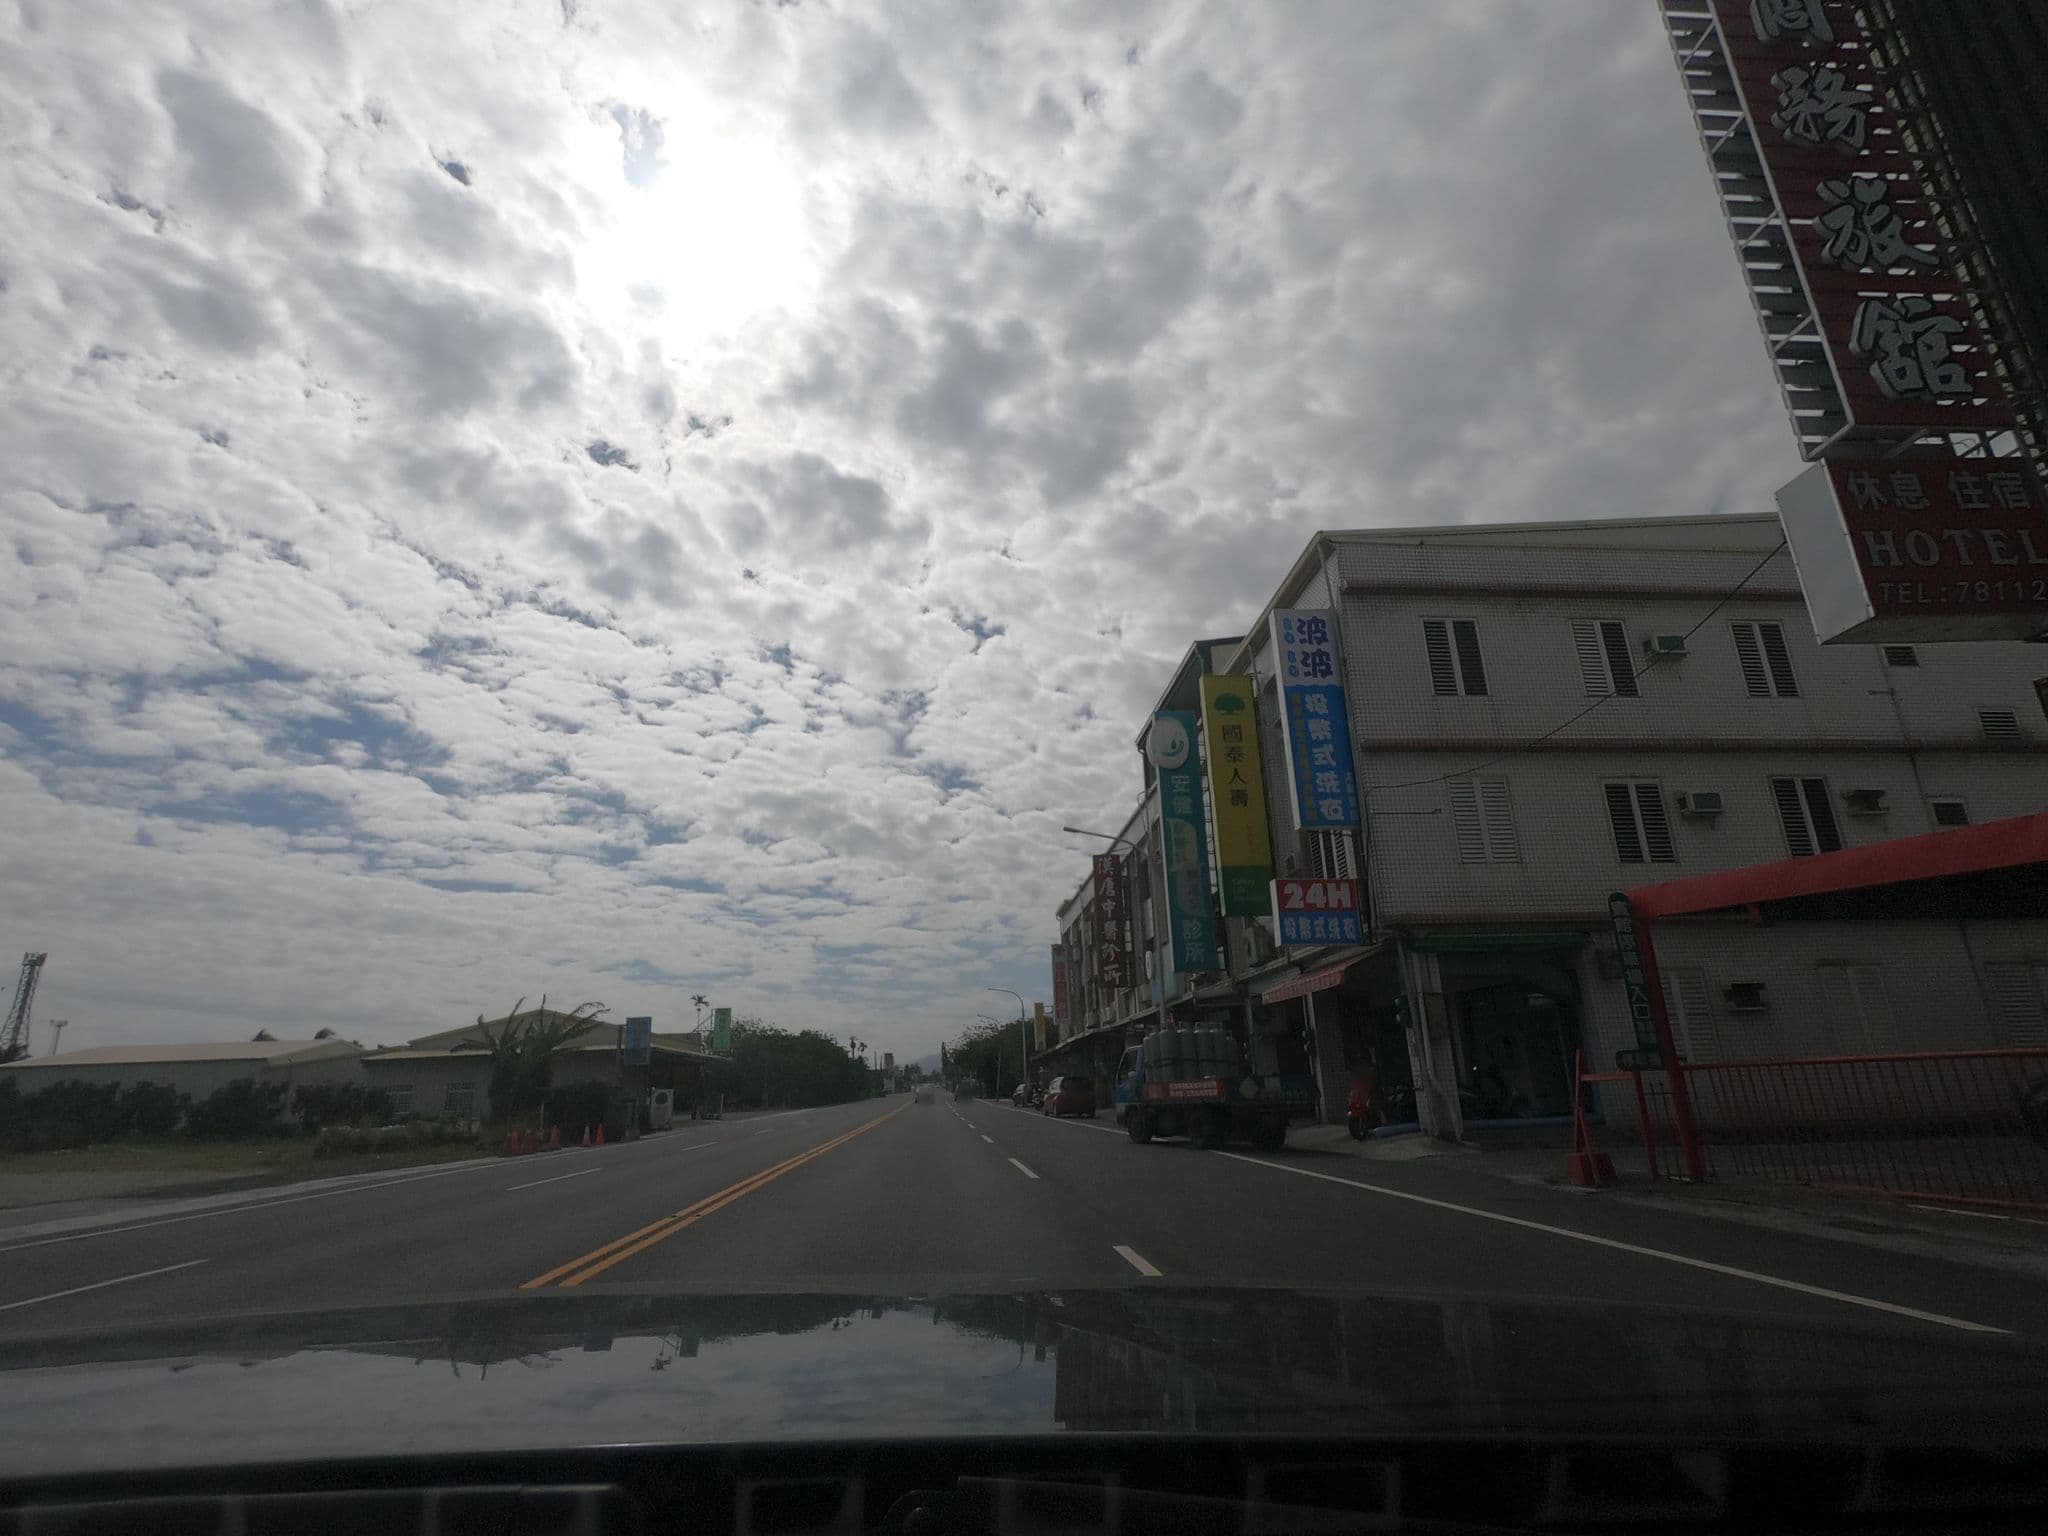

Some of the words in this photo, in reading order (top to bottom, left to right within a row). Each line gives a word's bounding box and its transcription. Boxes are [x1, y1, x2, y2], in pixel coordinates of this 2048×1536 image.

[1847, 470, 1931, 511] 休息
[1947, 470, 2032, 511] 住宿
[1862, 528, 2048, 568] HOTEL
[1297, 615, 1333, 679] 波波
[1221, 724, 1250, 808] 國泰人壽
[1283, 881, 1351, 909] 24H
